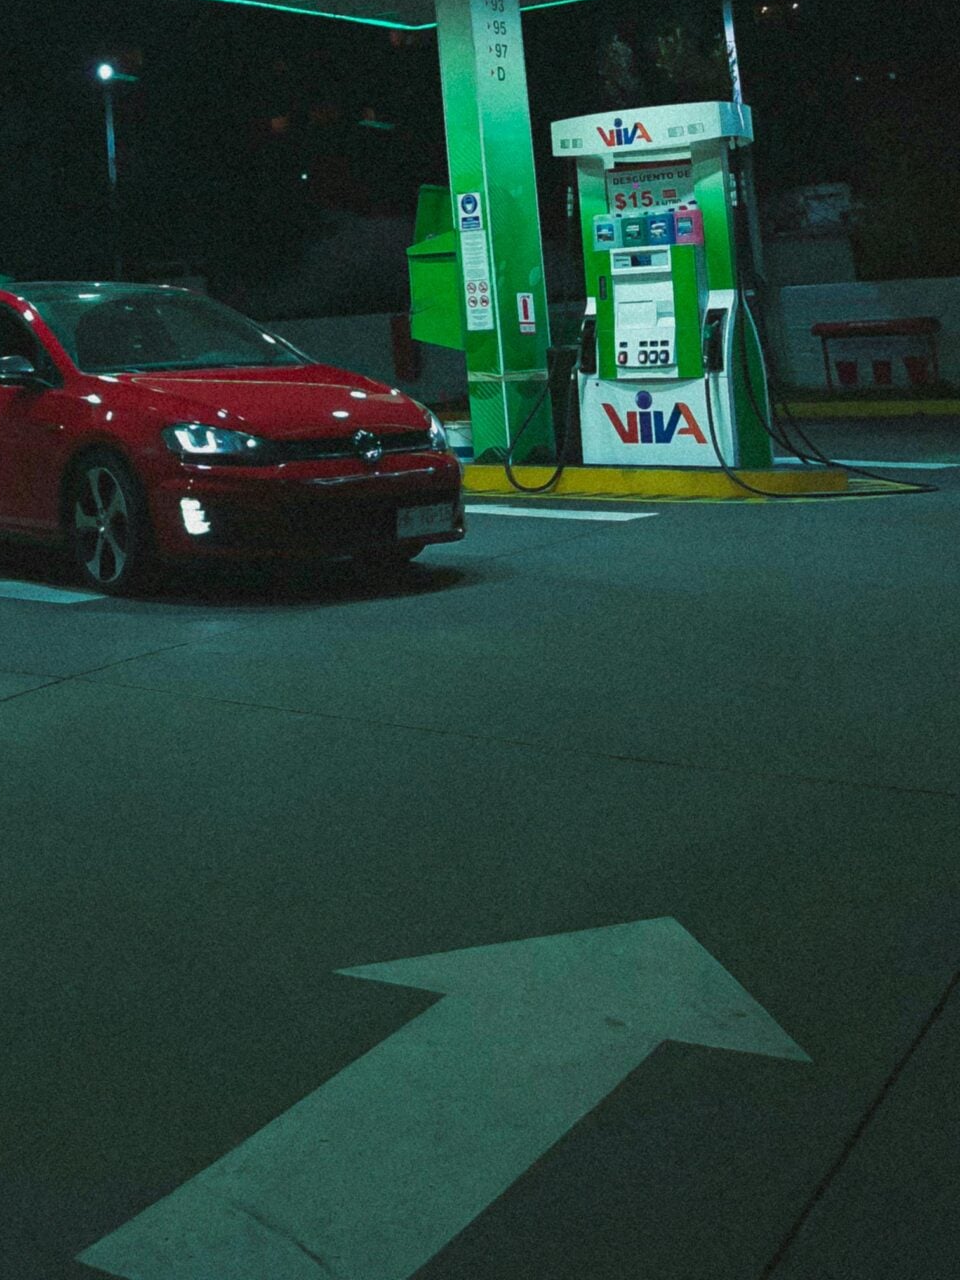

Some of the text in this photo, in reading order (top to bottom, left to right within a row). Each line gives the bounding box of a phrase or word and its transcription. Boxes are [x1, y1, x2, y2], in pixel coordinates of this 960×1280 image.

[493, 21, 507, 36] 95
[495, 44, 508, 59] 97
[497, 66, 506, 81] D
[612, 169, 690, 186] DESCUENTO DE
[614, 190, 654, 211] $15
